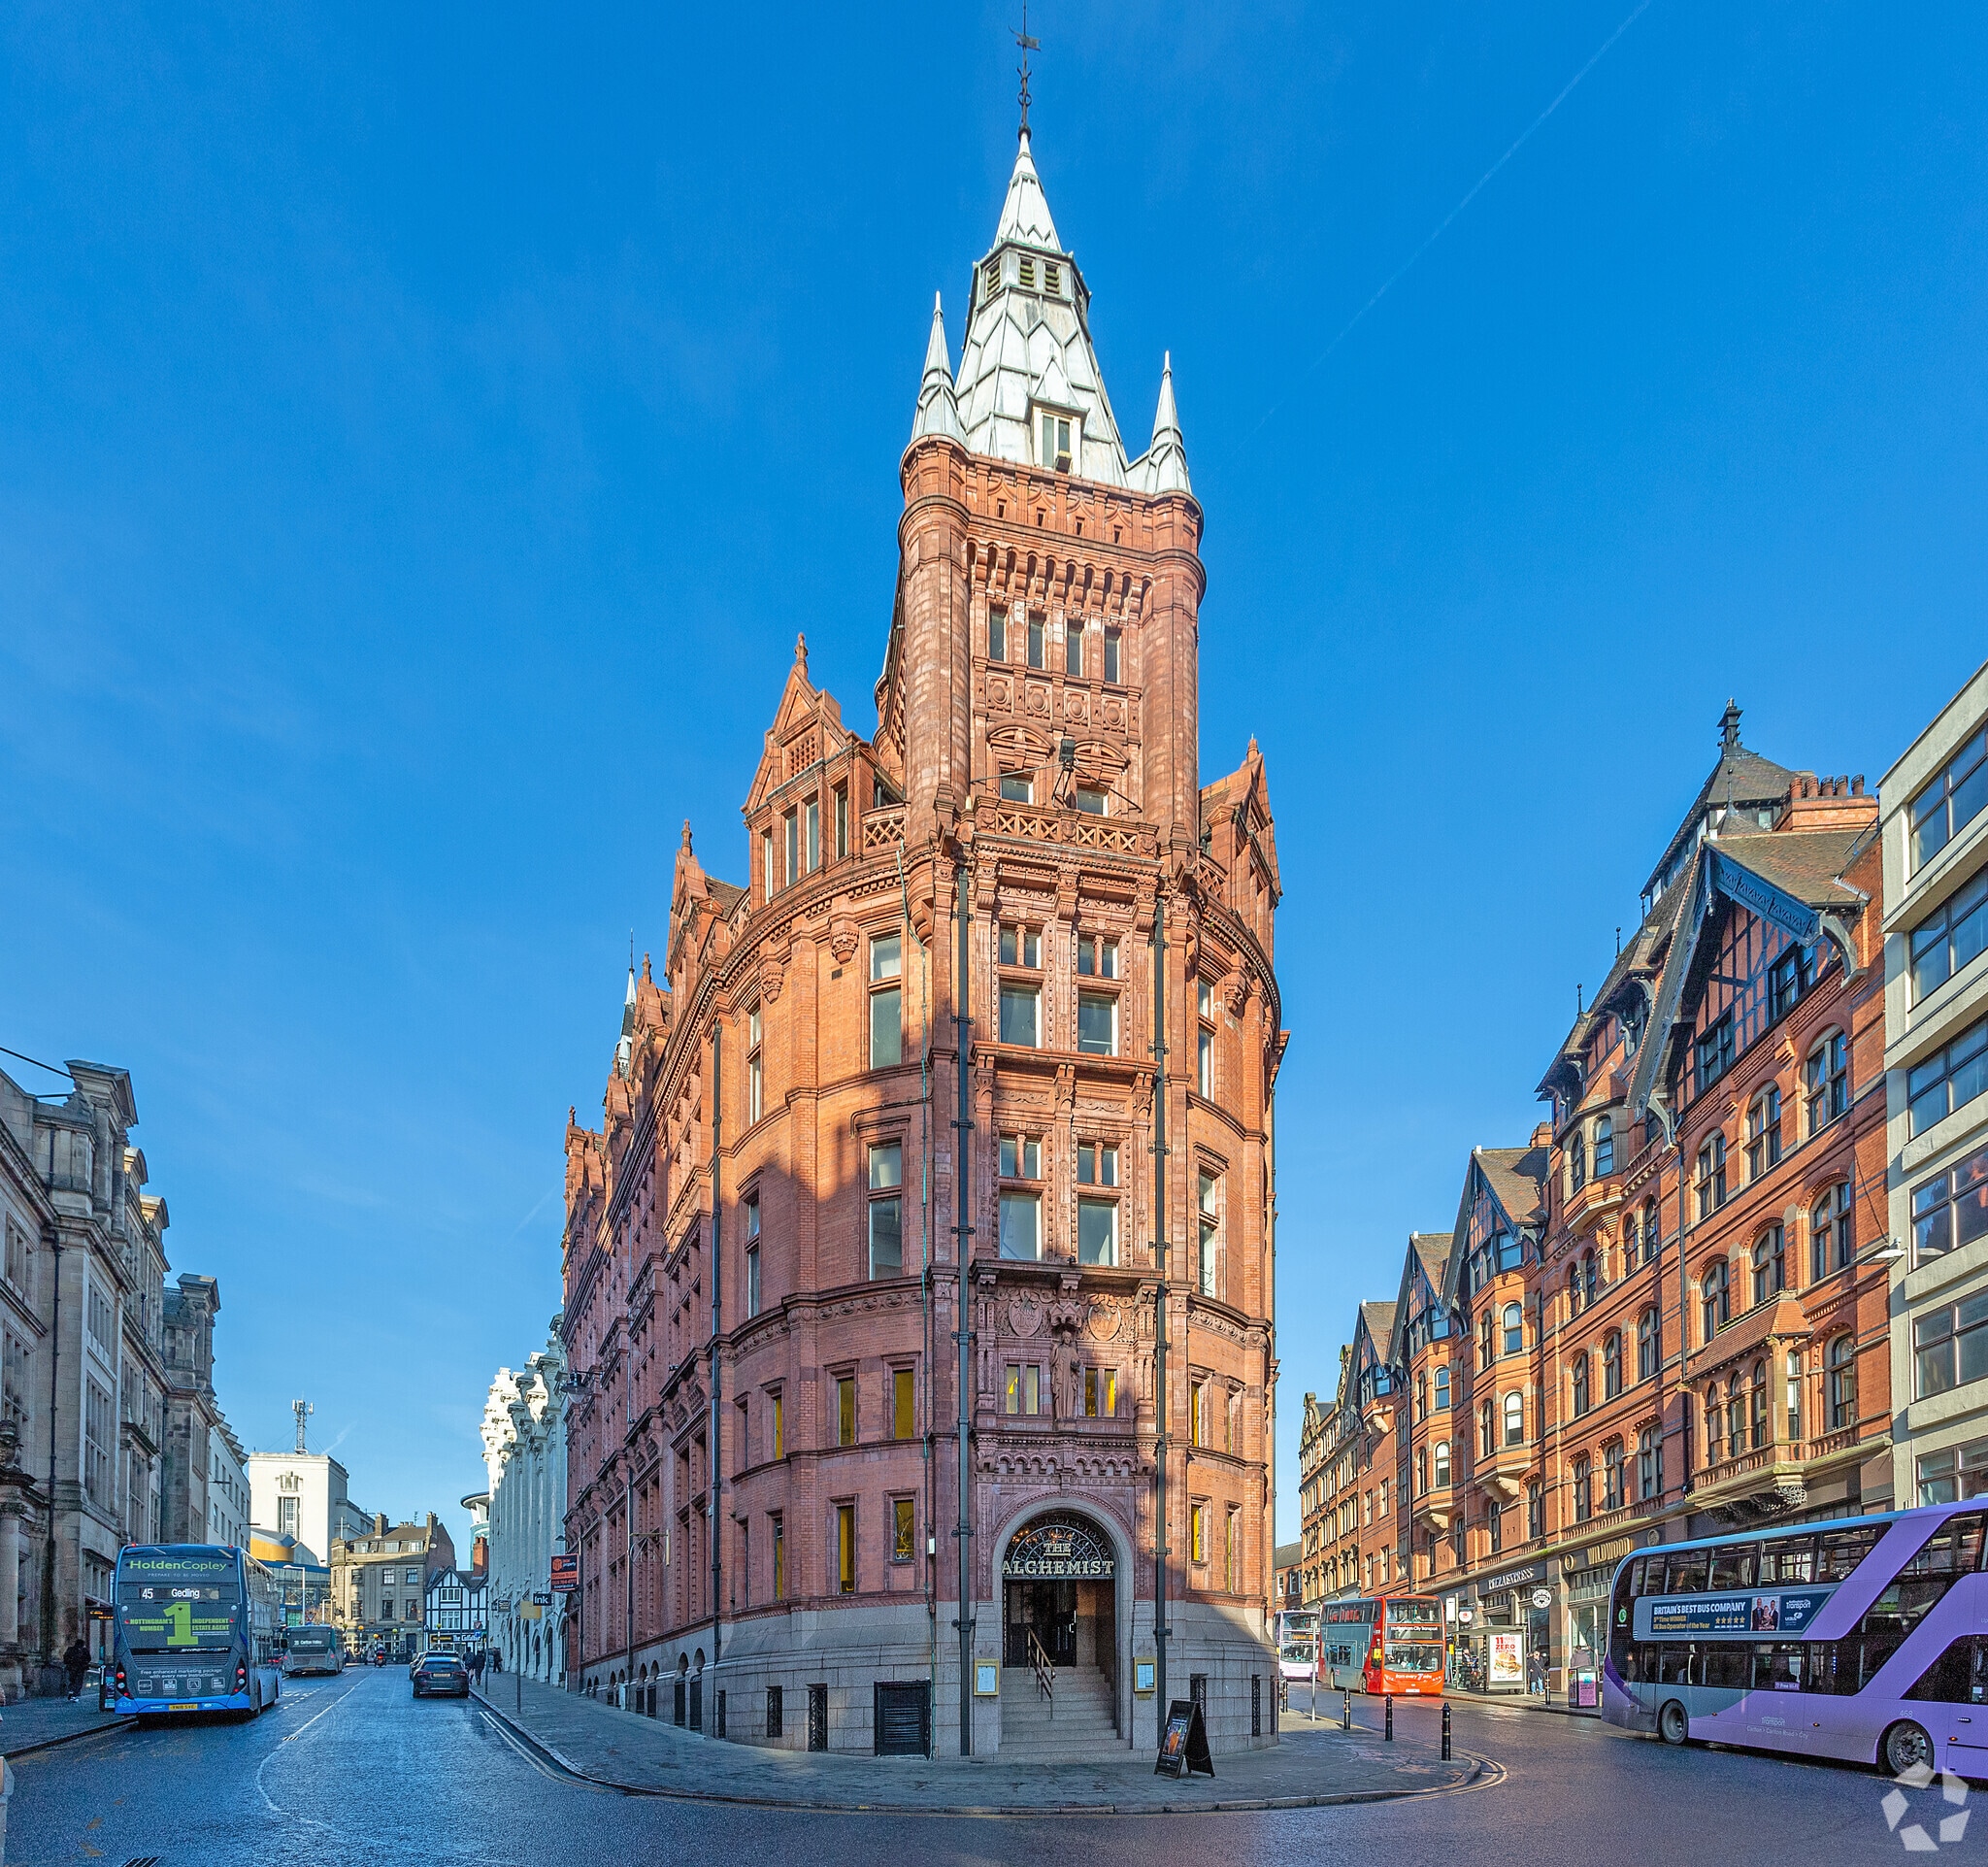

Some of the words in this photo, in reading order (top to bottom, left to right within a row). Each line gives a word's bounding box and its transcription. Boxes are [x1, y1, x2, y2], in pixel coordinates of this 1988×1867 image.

[1043, 1543, 1071, 1553] THE
[1587, 1537, 1632, 1565] WILDWOOD
[130, 1561, 227, 1571] HoldenCopley
[1002, 1561, 1114, 1574] ALCHEMIST
[142, 1588, 153, 1599] 45
[171, 1588, 200, 1599] Gedling
[1654, 1604, 1681, 1615] BRITAIN'S
[1681, 1604, 1697, 1614] BEST
[1698, 1604, 1710, 1613] BUS
[1710, 1602, 1746, 1612] COMPANY
[163, 1602, 198, 1645] 1
